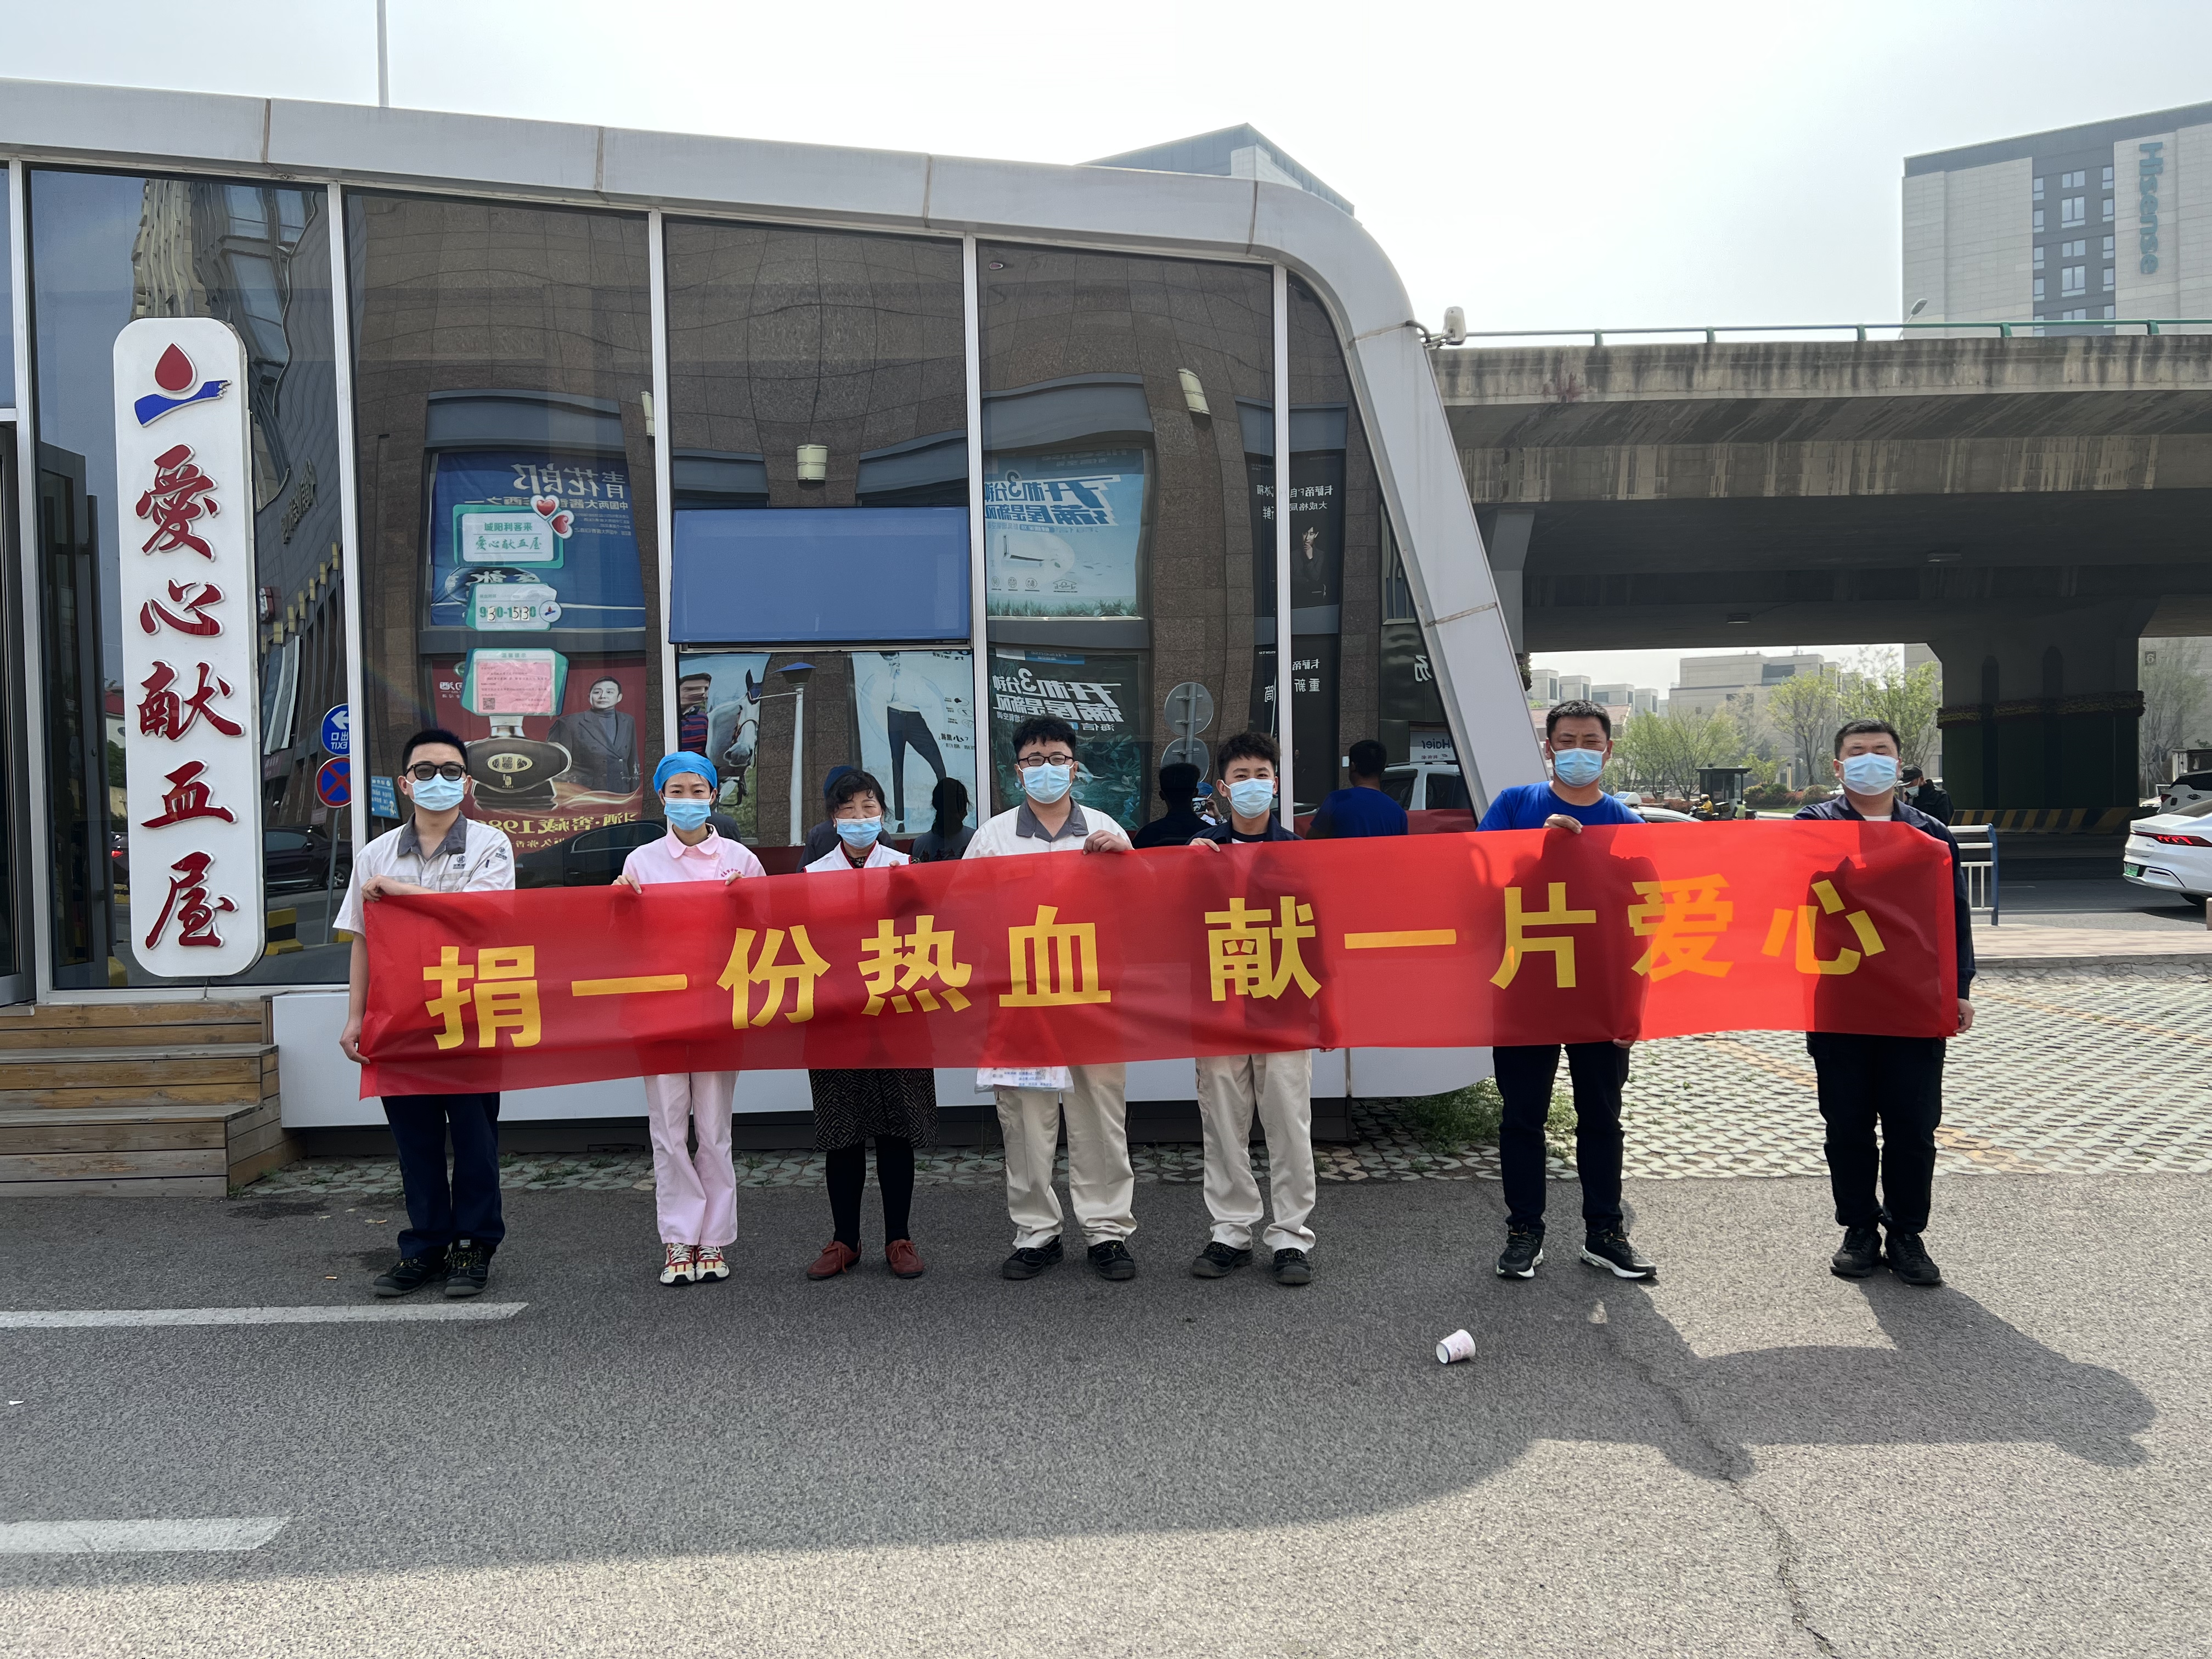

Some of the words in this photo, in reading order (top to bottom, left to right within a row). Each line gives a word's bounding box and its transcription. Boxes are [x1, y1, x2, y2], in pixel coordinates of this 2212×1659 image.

[2138, 141, 2164, 275] Hisense
[484, 522, 533, 532] 城阳利客来
[2147, 653, 2154, 663] 6
[423, 905, 1111, 1049] 捐一份热血
[1204, 873, 1886, 1002] 献一片爱心
